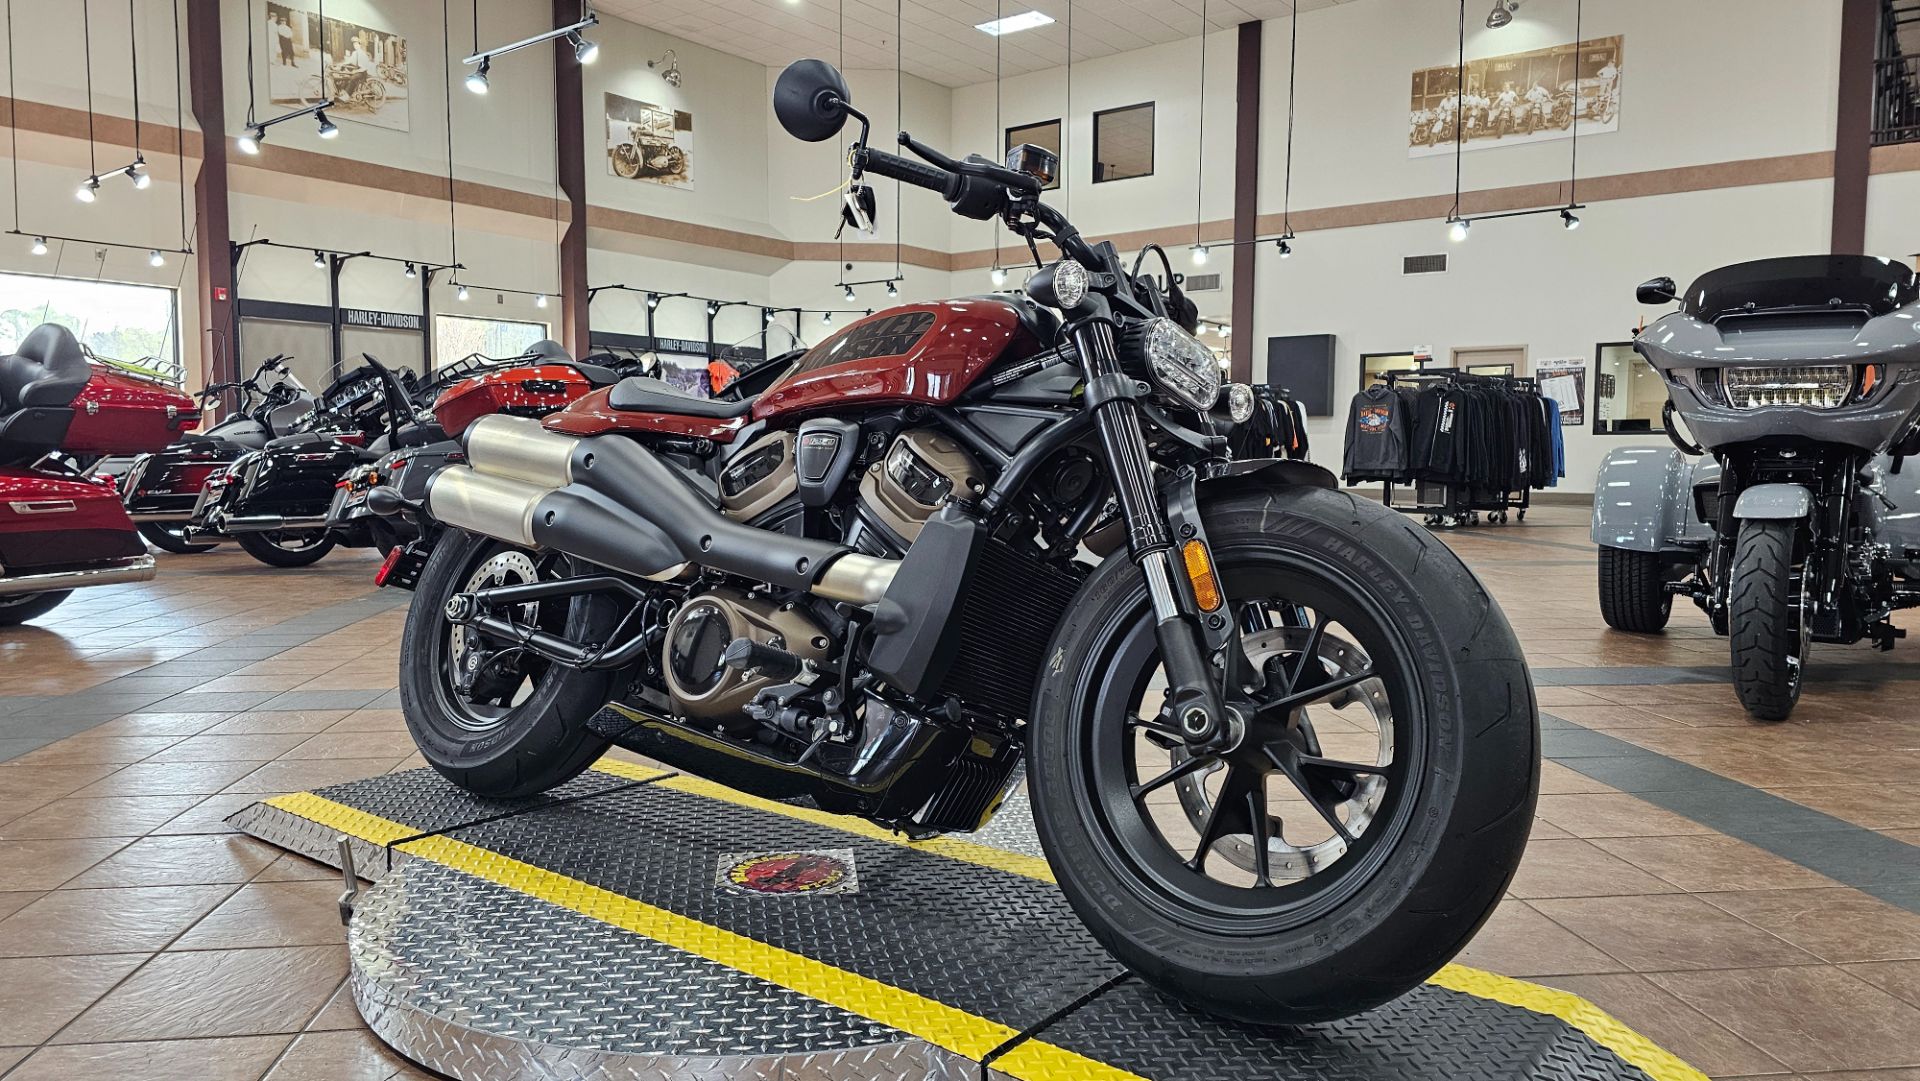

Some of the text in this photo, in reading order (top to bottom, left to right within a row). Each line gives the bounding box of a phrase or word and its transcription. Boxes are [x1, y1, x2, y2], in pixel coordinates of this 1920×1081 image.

[347, 310, 420, 329] HARLEY-DAVIDSON
[659, 339, 707, 353] HARLEY-DAVIDSON
[1322, 535, 1452, 756] HARLEY-DAVIDSON
